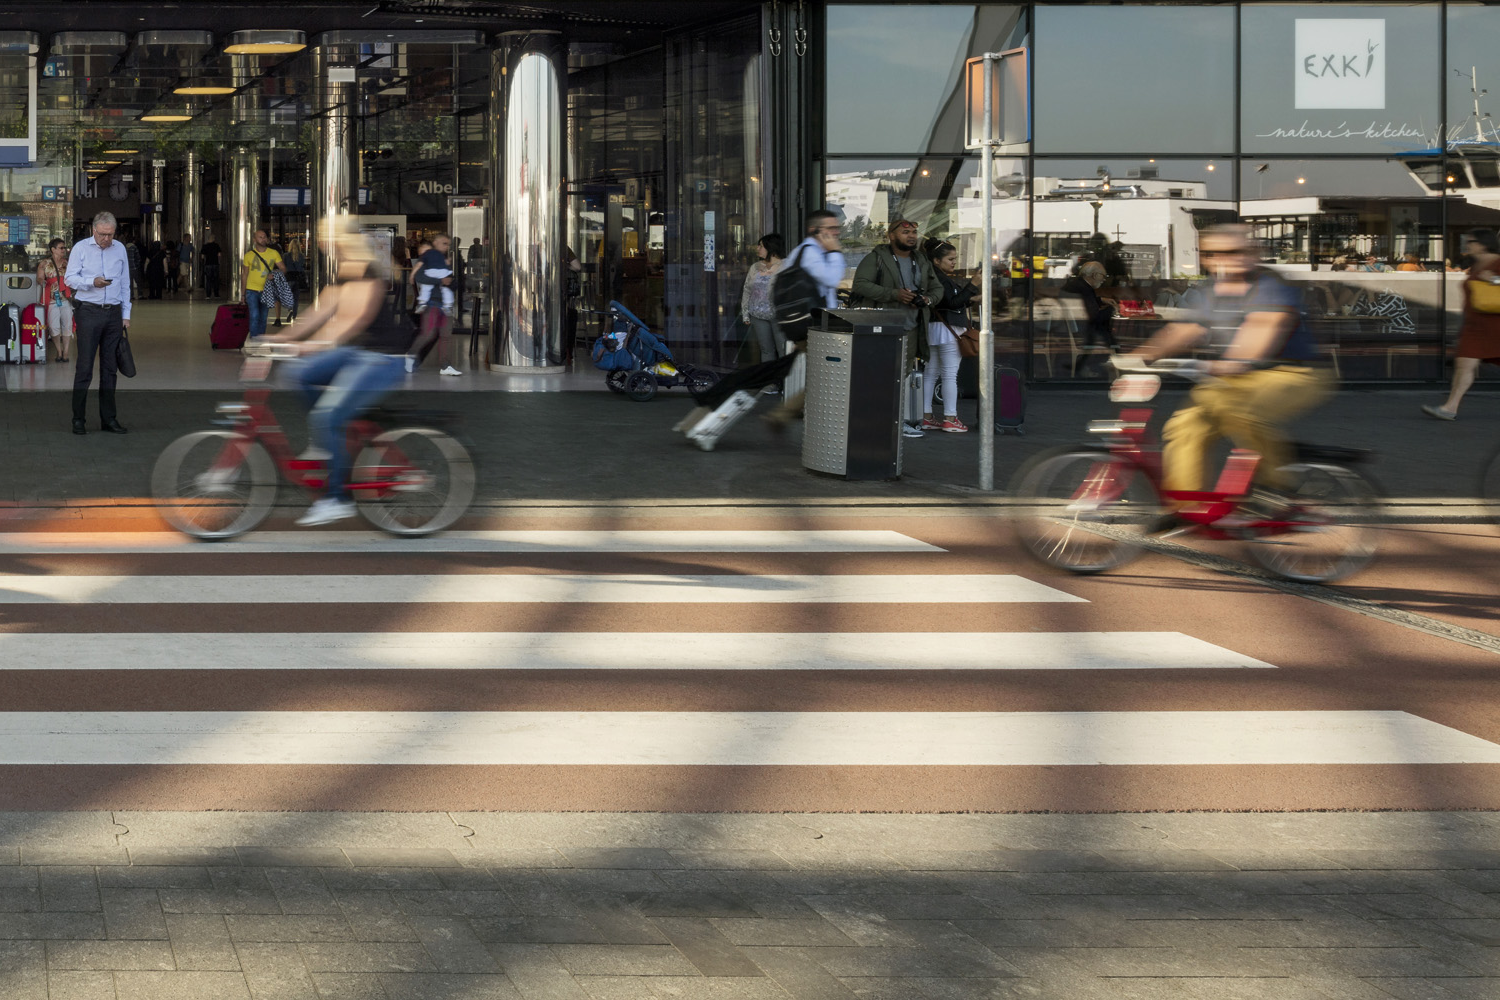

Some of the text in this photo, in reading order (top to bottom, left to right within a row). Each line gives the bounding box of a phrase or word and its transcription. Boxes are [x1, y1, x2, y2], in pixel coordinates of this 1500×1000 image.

[1257, 120, 1425, 138] nature's kitchen
[45, 189, 54, 198] G
